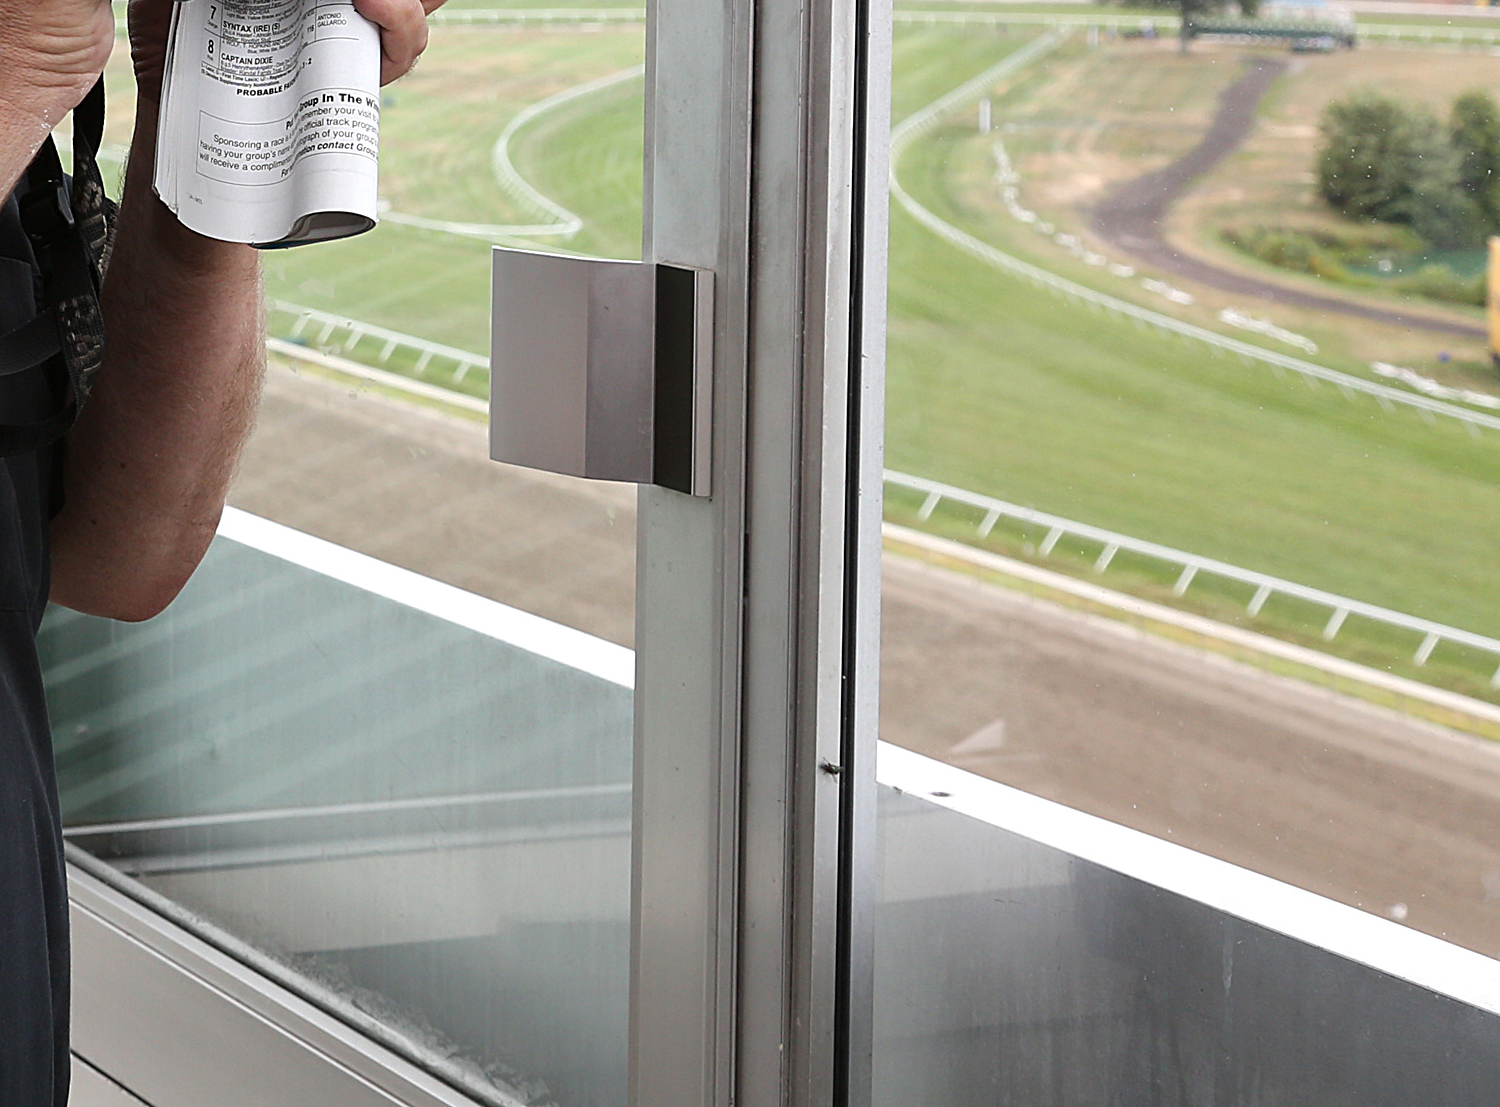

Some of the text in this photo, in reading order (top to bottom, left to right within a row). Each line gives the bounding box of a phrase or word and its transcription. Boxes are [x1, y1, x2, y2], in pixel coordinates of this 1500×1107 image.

[210, 5, 217, 19] 7
[223, 21, 252, 32] SYNTAX
[252, 24, 271, 34] (IRE)
[318, 19, 347, 28] GALLARDO
[208, 40, 214, 54] 8
[221, 53, 253, 65] CAPTAIN
[254, 56, 274, 65] DIXIE
[236, 85, 283, 97] PROBABLE
[322, 93, 334, 103] In
[338, 93, 363, 105] The
[334, 107, 357, 116] your
[326, 117, 350, 126] track
[321, 129, 331, 138] of
[333, 130, 354, 140] your
[213, 133, 262, 150] Sponsoring
[271, 137, 285, 147] race
[317, 141, 355, 151] contact
[200, 140, 222, 157] having
[223, 150, 243, 160] your
[245, 149, 276, 162] group's
[199, 152, 210, 162] will
[210, 156, 240, 170] receive
